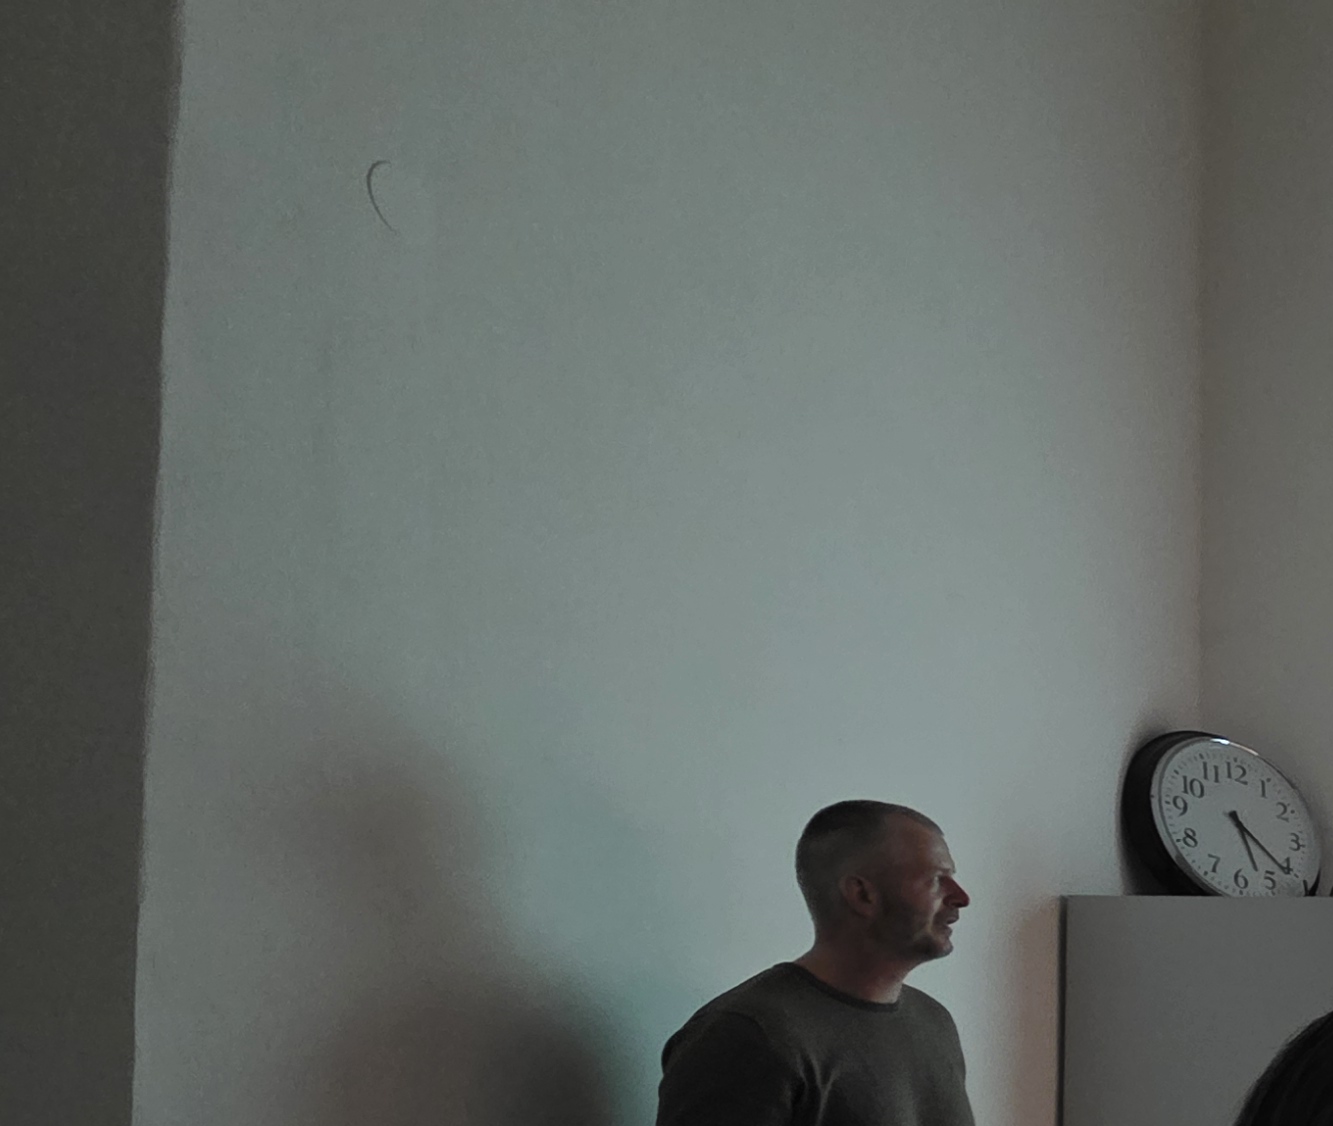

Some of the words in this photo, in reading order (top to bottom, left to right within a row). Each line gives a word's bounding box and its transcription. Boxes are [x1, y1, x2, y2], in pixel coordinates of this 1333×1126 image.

[1203, 761, 1220, 783] 11
[1226, 761, 1248, 785] 12
[1182, 775, 1205, 799] 10
[1260, 779, 1267, 798] 1
[1172, 796, 1188, 816] 9
[1276, 802, 1290, 822] 2
[1182, 827, 1198, 848] 8
[1289, 833, 1301, 851] 3
[1207, 854, 1221, 873] 7
[1233, 869, 1249, 889] 6
[1263, 870, 1277, 890] 5
